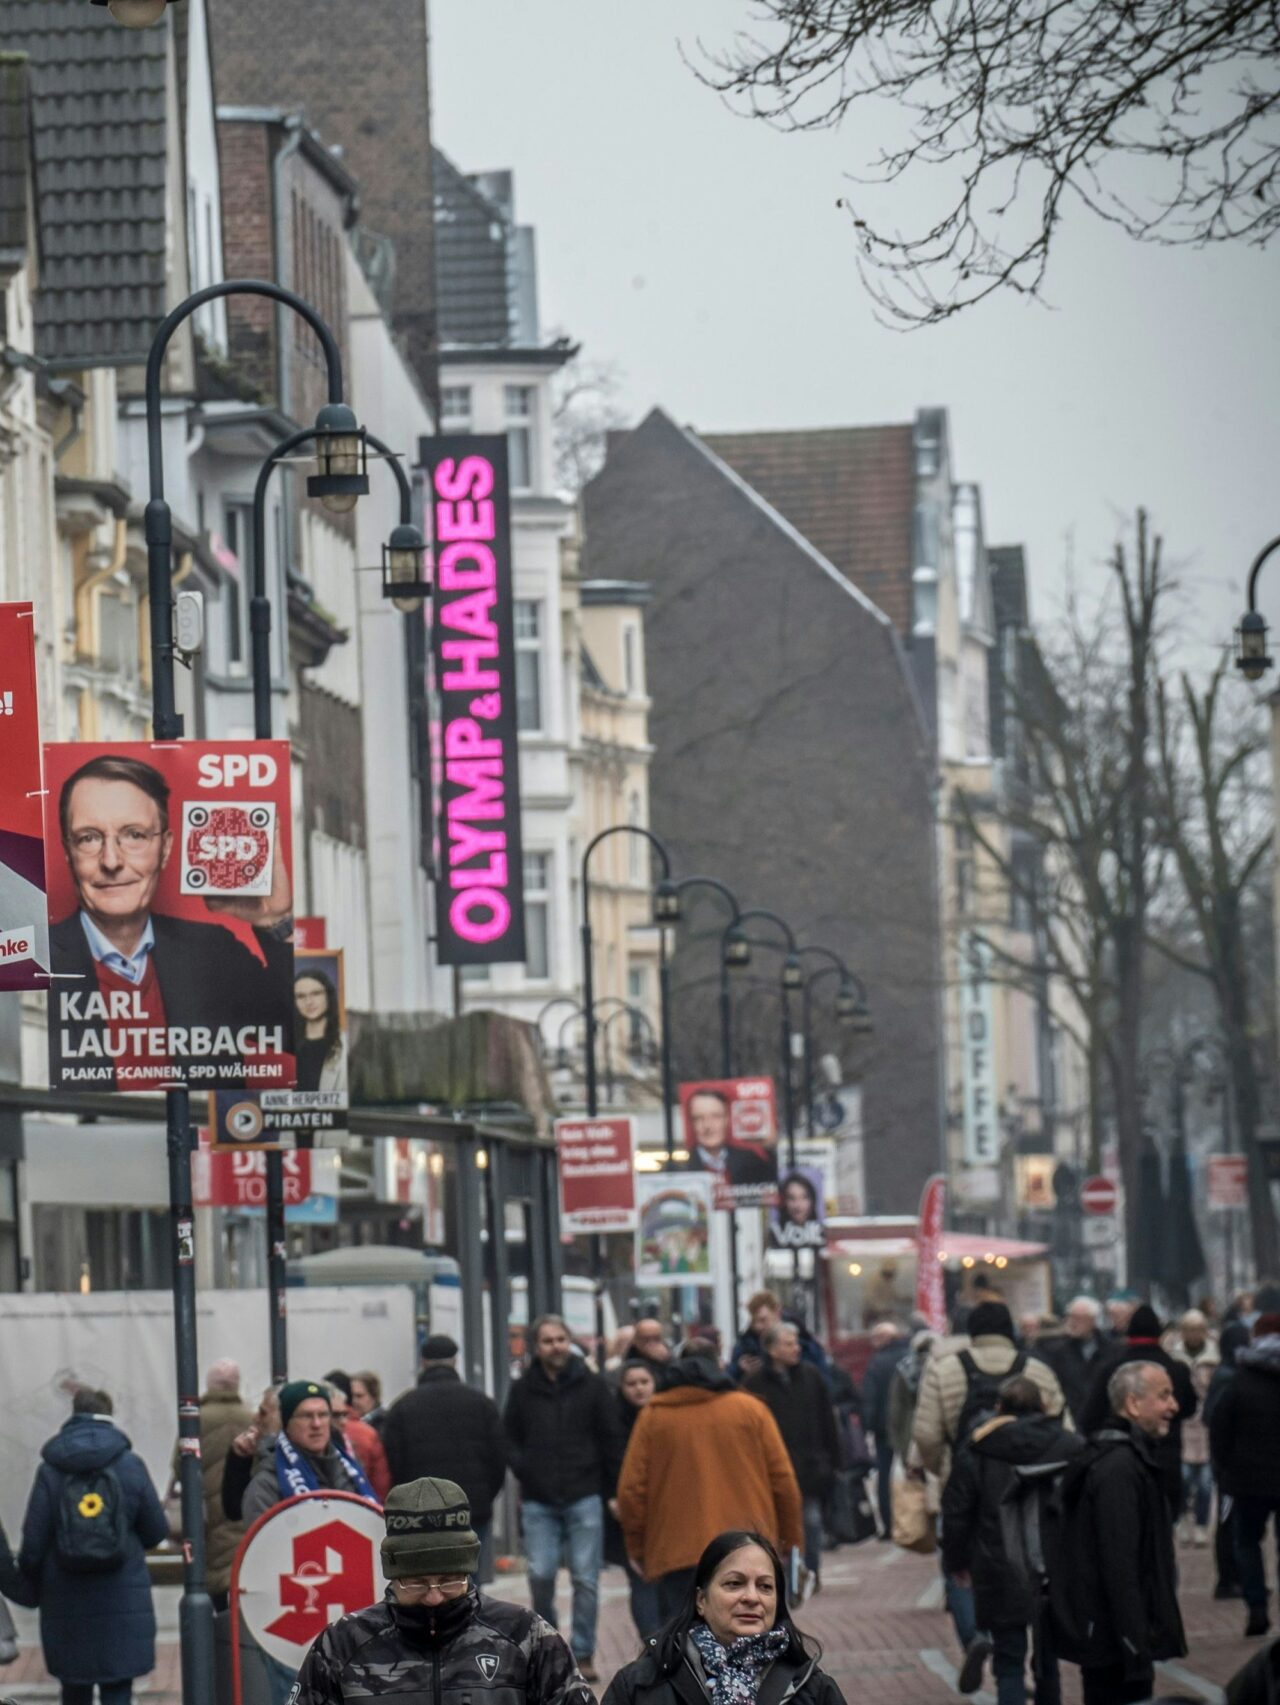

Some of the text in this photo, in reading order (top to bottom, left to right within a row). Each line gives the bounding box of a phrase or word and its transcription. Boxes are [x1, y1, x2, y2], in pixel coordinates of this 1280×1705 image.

[197, 753, 278, 788] SPD
[197, 834, 259, 862] SPD
[59, 990, 149, 1021] KARL
[60, 1025, 283, 1058] LAUTERBACH
[61, 1062, 283, 1081] PLAKAT SCANNEN, SPD WÄHLEN!
[264, 1092, 289, 1106] ANNE
[263, 1112, 334, 1128] PIRATEN
[233, 1176, 301, 1203] TOR
[387, 1515, 423, 1530] FOX
